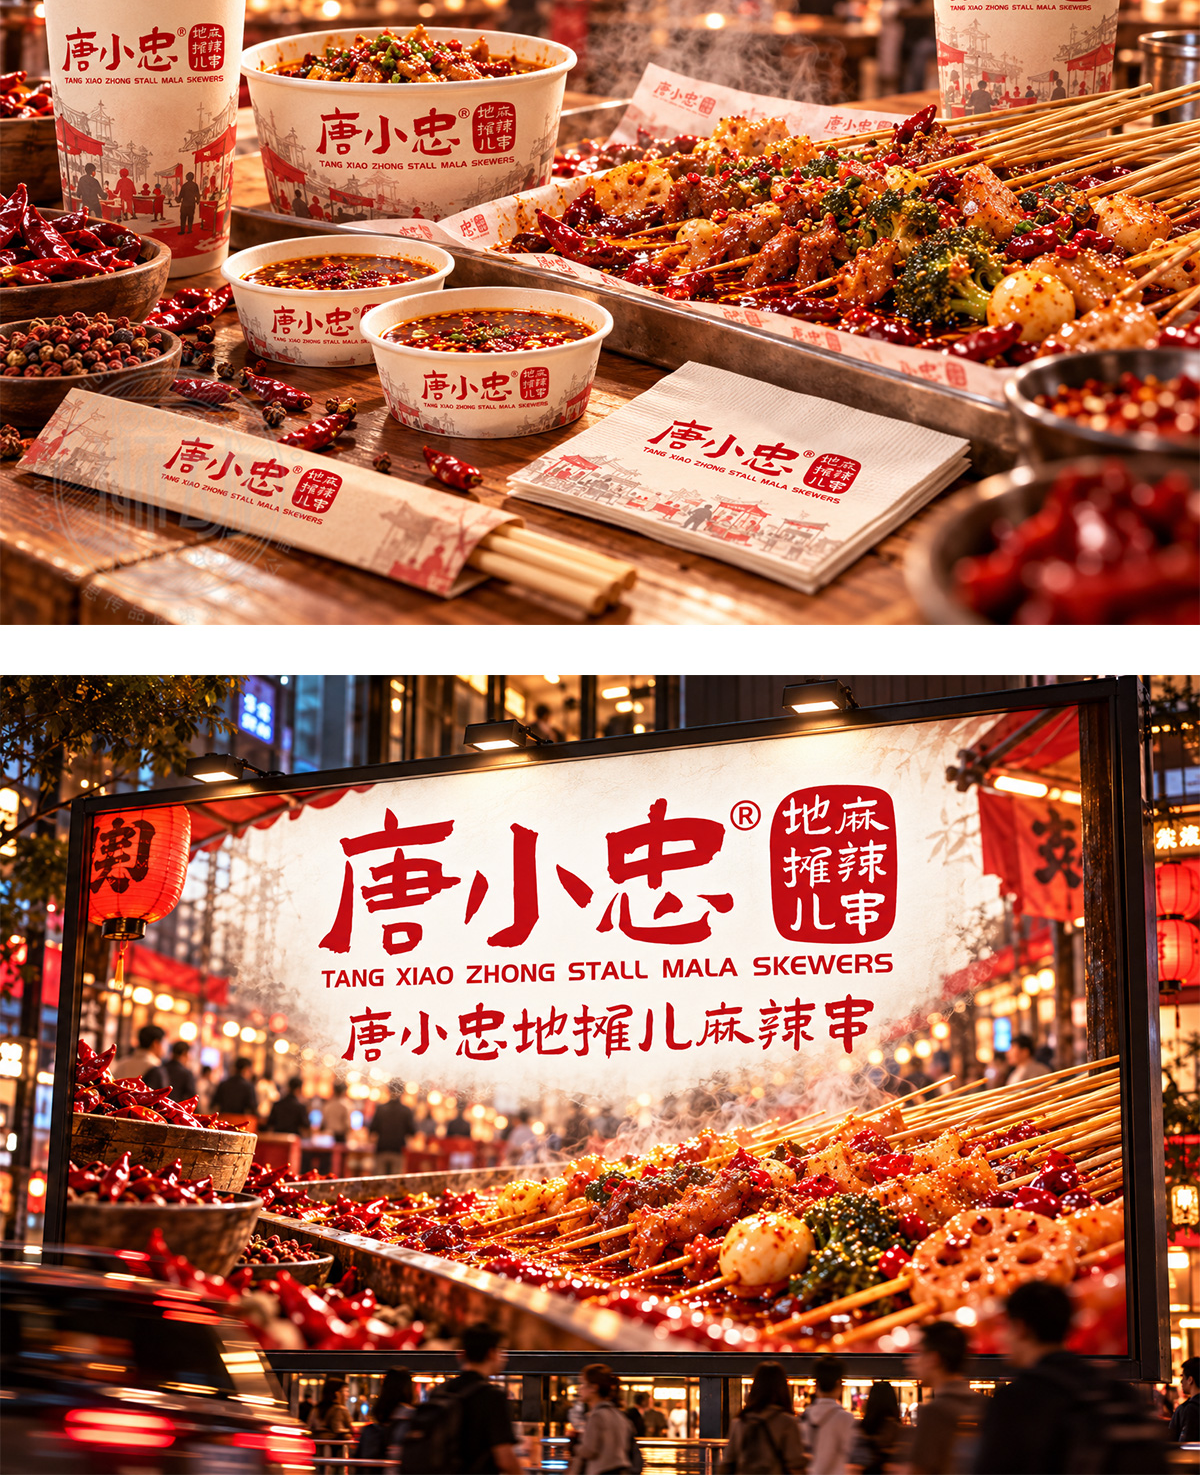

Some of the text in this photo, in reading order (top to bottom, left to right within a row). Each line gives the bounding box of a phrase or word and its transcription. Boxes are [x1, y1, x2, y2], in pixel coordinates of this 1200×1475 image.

[62, 26, 178, 72] 唐小忠
[316, 107, 461, 156] 唐小忠
[319, 160, 342, 168] TANG
[472, 156, 515, 166] SKEWERS
[271, 306, 354, 336] 唐小忠
[422, 370, 513, 402] 唐小忠
[162, 437, 290, 497] 唐小忠
[642, 447, 841, 504] TANG XIAO ZHONG STALL MALA SKEWERS
[647, 420, 799, 476] 唐小忠
[319, 798, 735, 956] 唐小忠
[782, 795, 835, 933] 地摊儿
[834, 796, 890, 937] 麻辣串
[322, 953, 893, 988] TANG XIAO ZHONG STALL MALA SKEWERS
[341, 994, 874, 1065] 唐小忠地摊儿麻辣串
